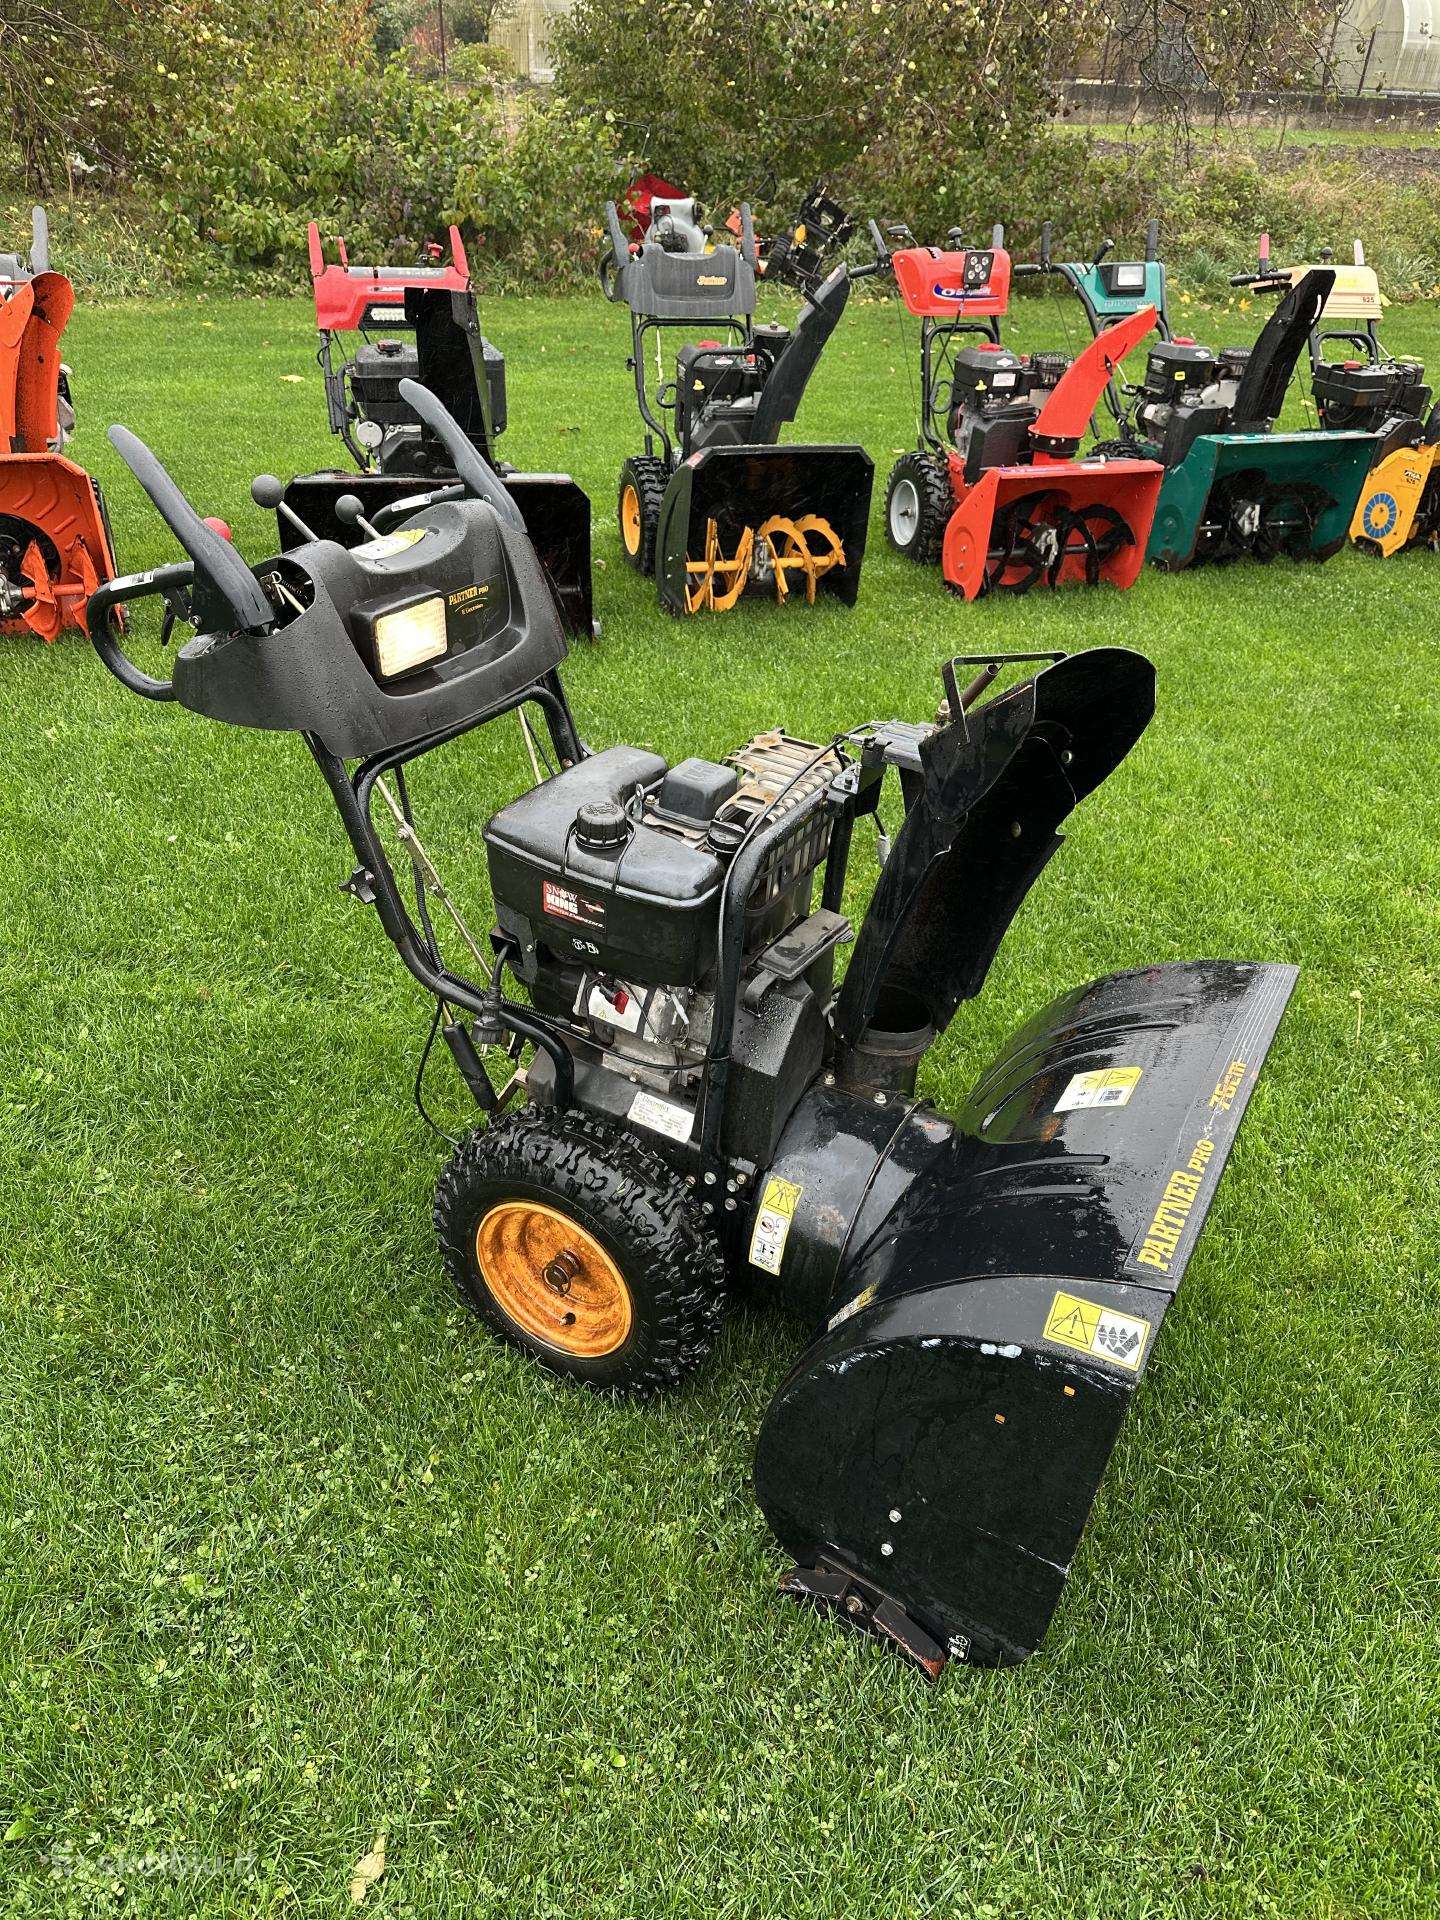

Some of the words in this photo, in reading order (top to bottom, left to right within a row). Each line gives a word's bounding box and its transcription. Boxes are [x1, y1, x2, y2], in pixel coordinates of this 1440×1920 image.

[448, 586, 478, 606] PARTNER
[478, 585, 489, 595] PRO
[546, 893, 578, 914] KING
[1136, 1170, 1203, 1272] PARTNER
[1187, 1139, 1215, 1174] PRO
